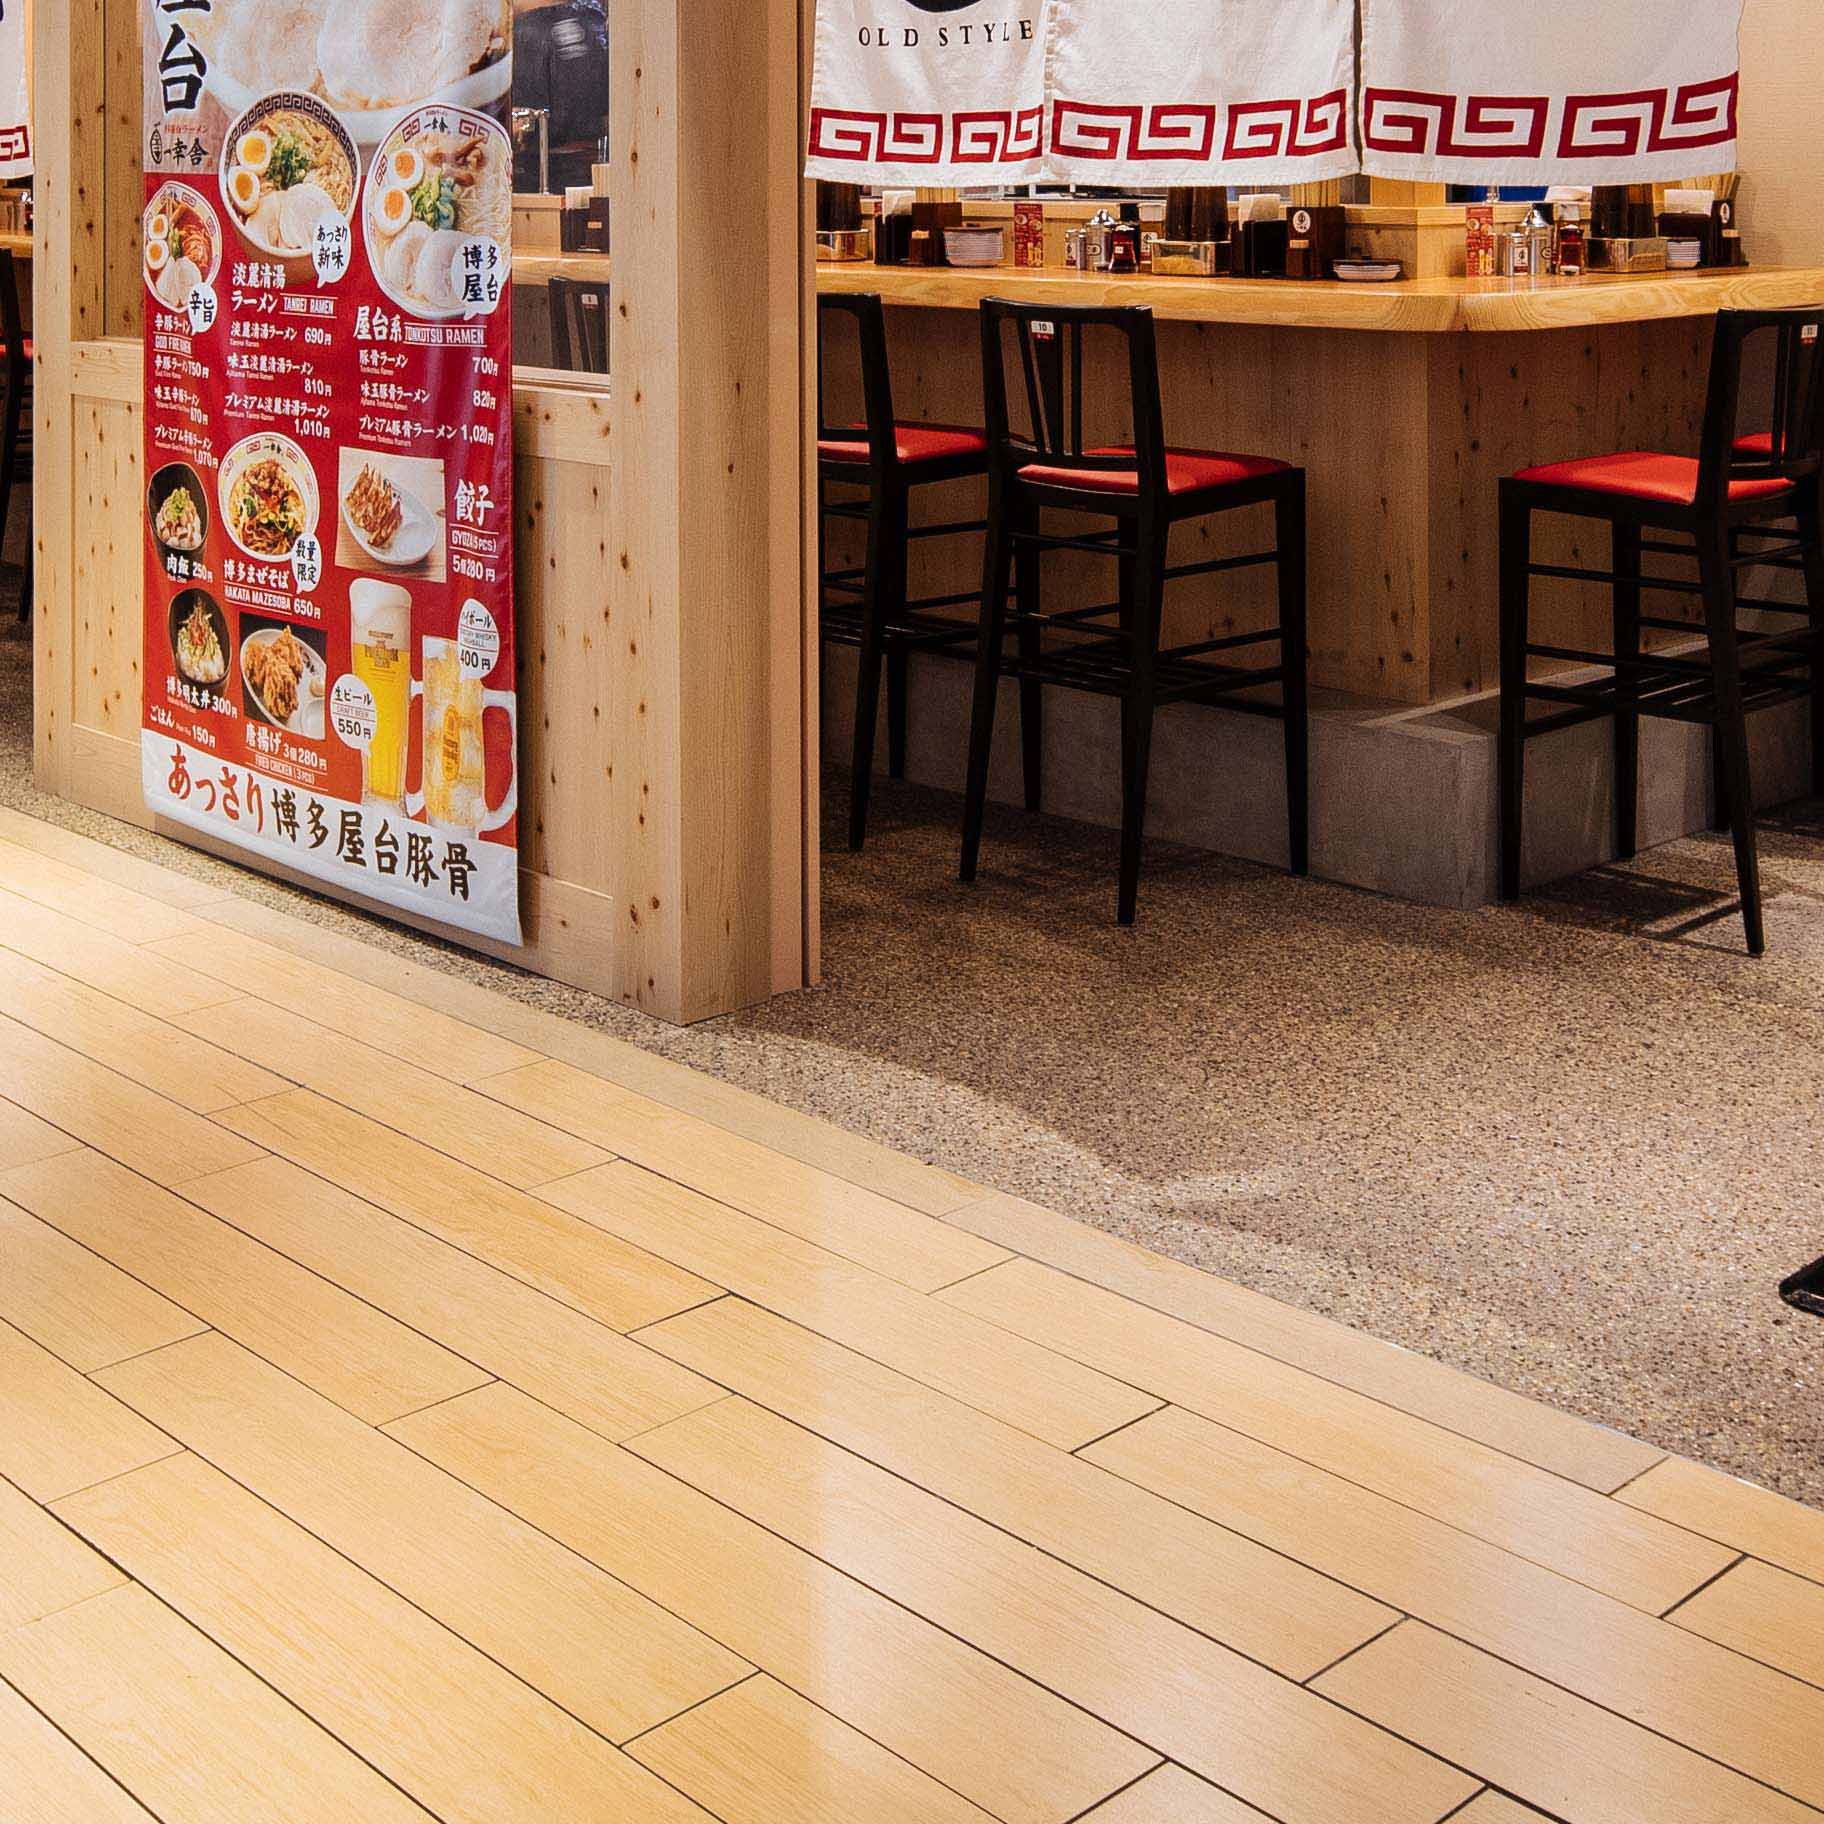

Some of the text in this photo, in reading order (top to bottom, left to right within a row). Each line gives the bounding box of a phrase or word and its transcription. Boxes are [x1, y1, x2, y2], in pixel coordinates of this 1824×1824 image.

[858, 20, 1034, 48] OLD STYLE
[317, 224, 348, 242] あっさり
[318, 246, 344, 270] 新味
[463, 245, 498, 270] 博多
[462, 273, 498, 303] 屋台
[231, 290, 278, 314] ラーメン
[304, 327, 332, 346] 690円
[352, 305, 402, 344] 屋台系
[446, 328, 484, 345] RAMEN
[472, 356, 499, 377] 700円
[304, 378, 332, 397] 810円
[472, 390, 497, 411] 820円
[294, 418, 331, 439] 1,010円
[460, 424, 495, 447] 1,020円
[454, 478, 495, 527] 餃子
[223, 559, 290, 590] 博多まぜそば
[297, 563, 317, 585] 限定
[293, 598, 321, 619] 650円
[212, 695, 238, 720] 300円
[334, 686, 373, 706] 生ビール
[150, 705, 175, 728] ごはん
[192, 725, 216, 749] 150円
[245, 722, 282, 754] 唐揚げ
[338, 718, 372, 740] 550円
